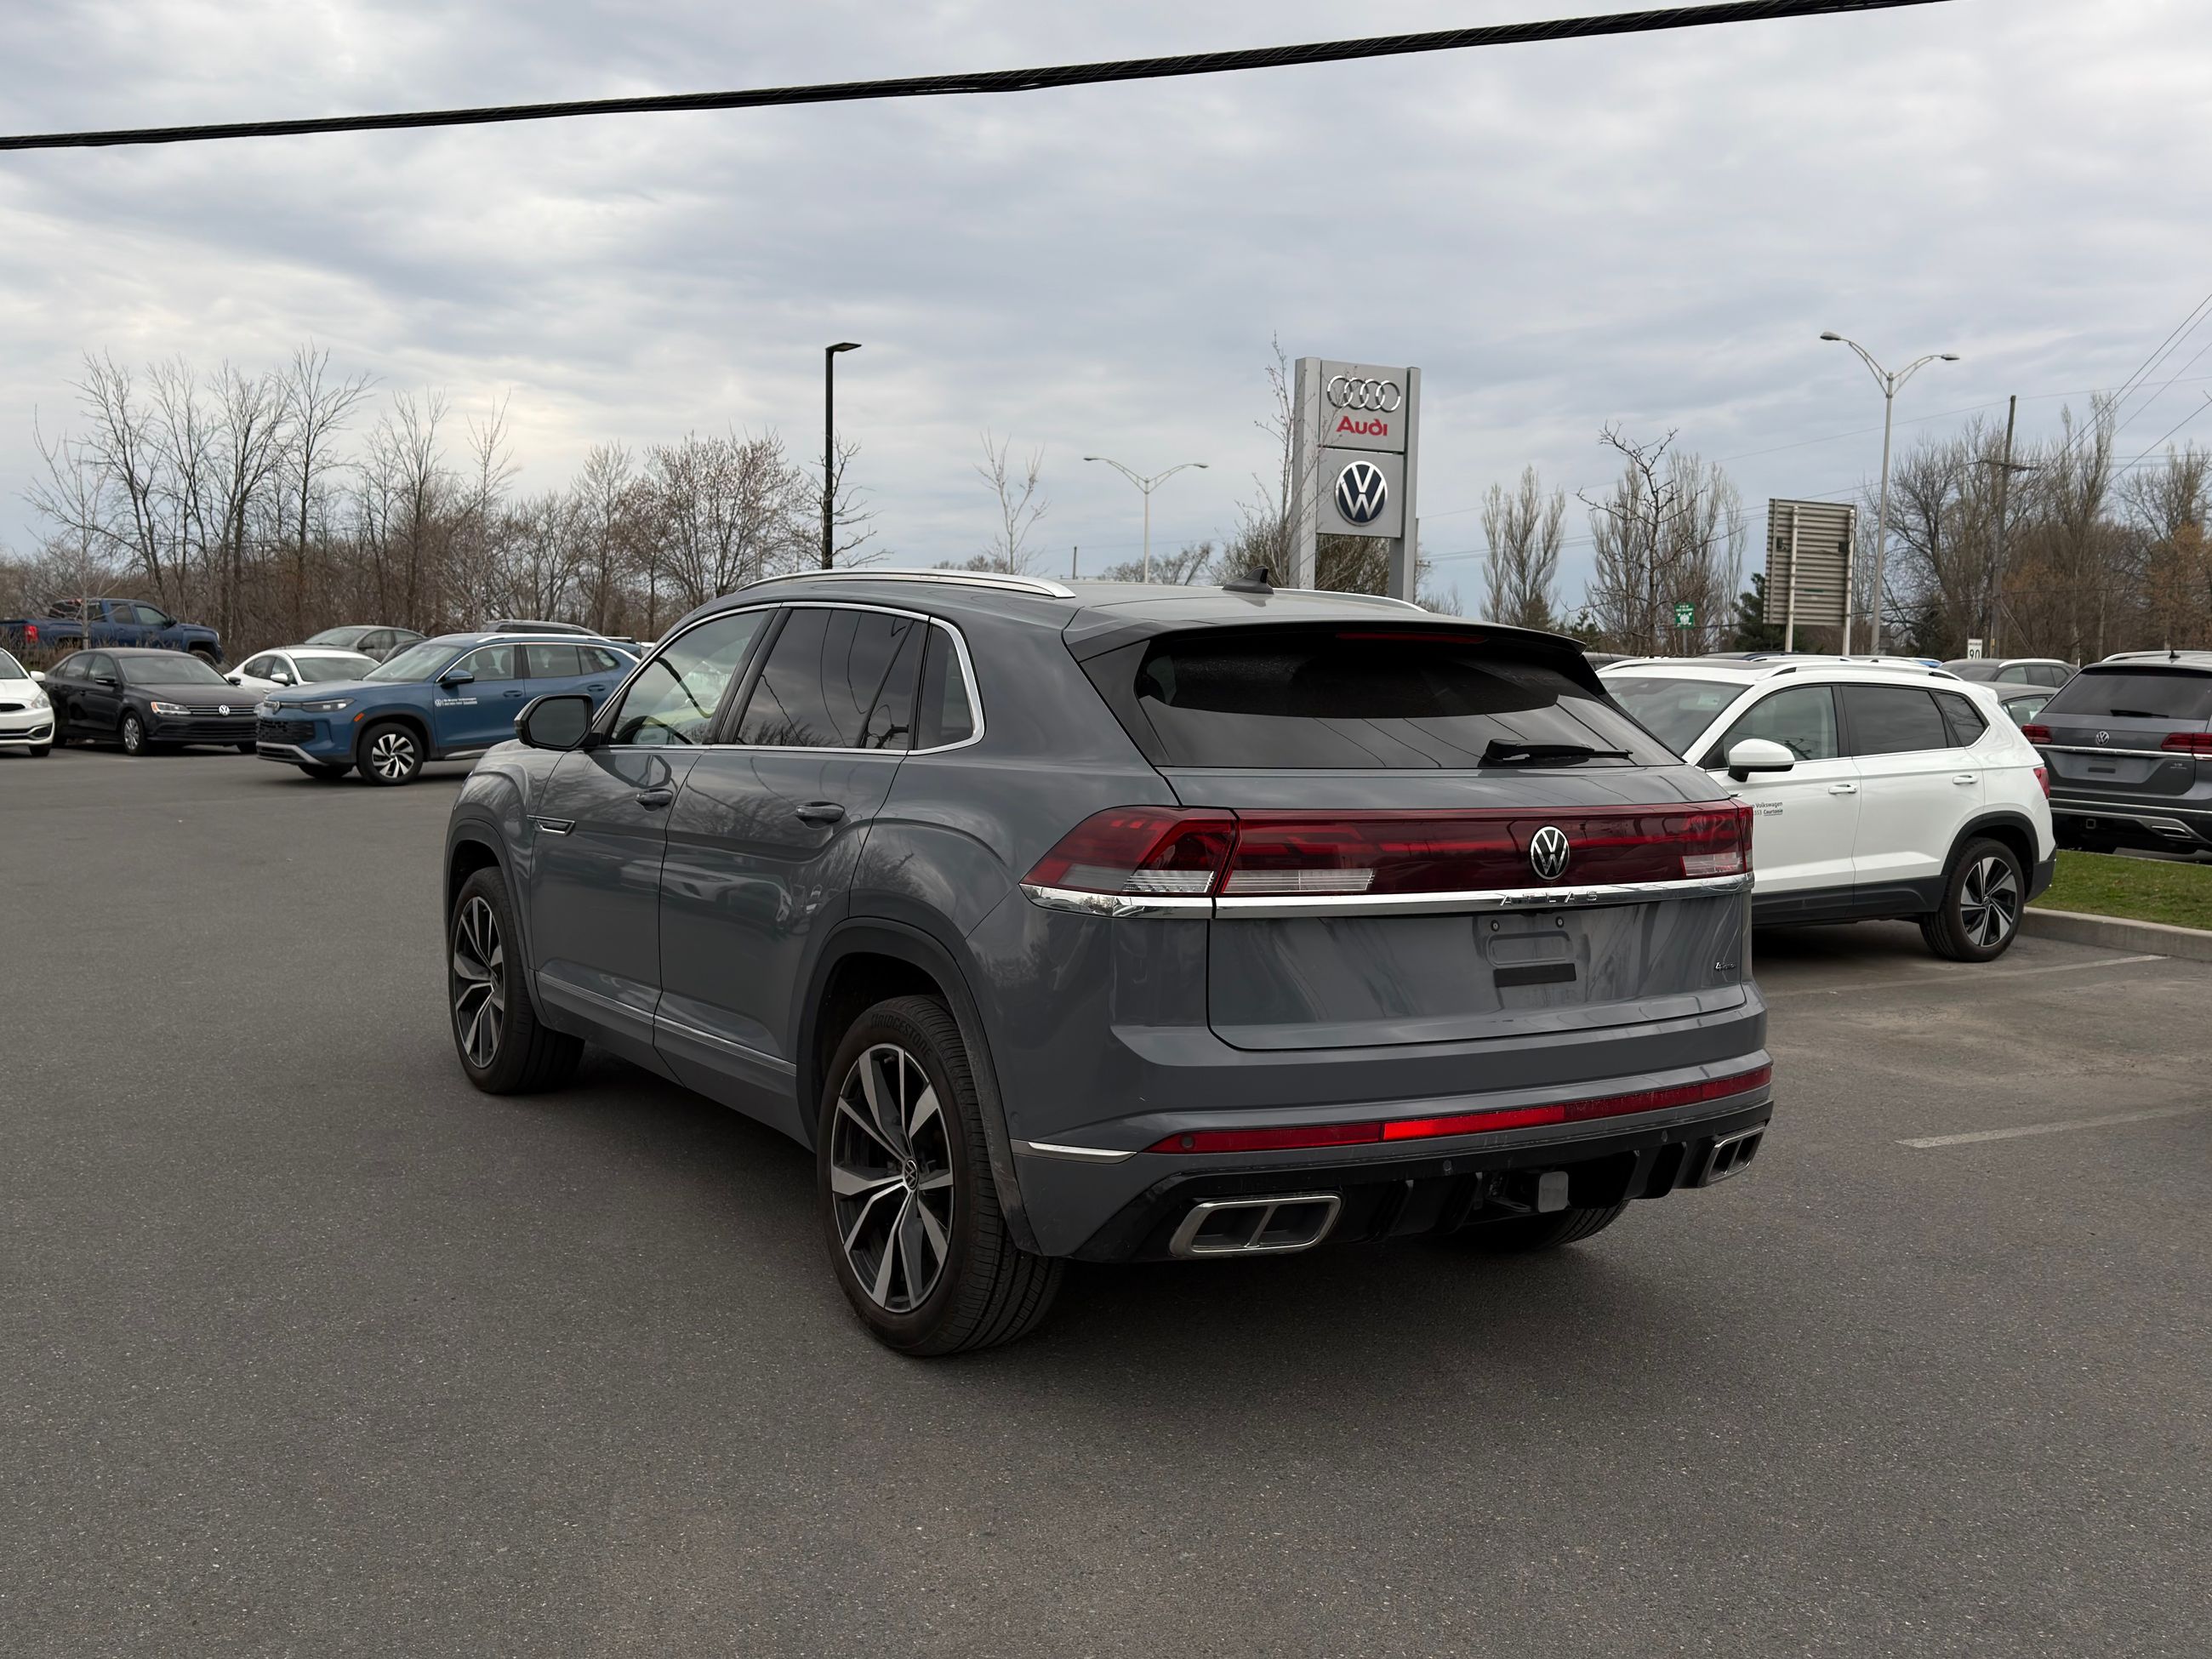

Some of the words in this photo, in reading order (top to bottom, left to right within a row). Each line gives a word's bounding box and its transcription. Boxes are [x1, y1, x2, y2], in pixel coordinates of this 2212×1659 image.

[1336, 415, 1388, 436] Audi
[1336, 461, 1388, 524] VW
[1531, 827, 1570, 879] VW
[1500, 891, 1598, 906] ATLAS
